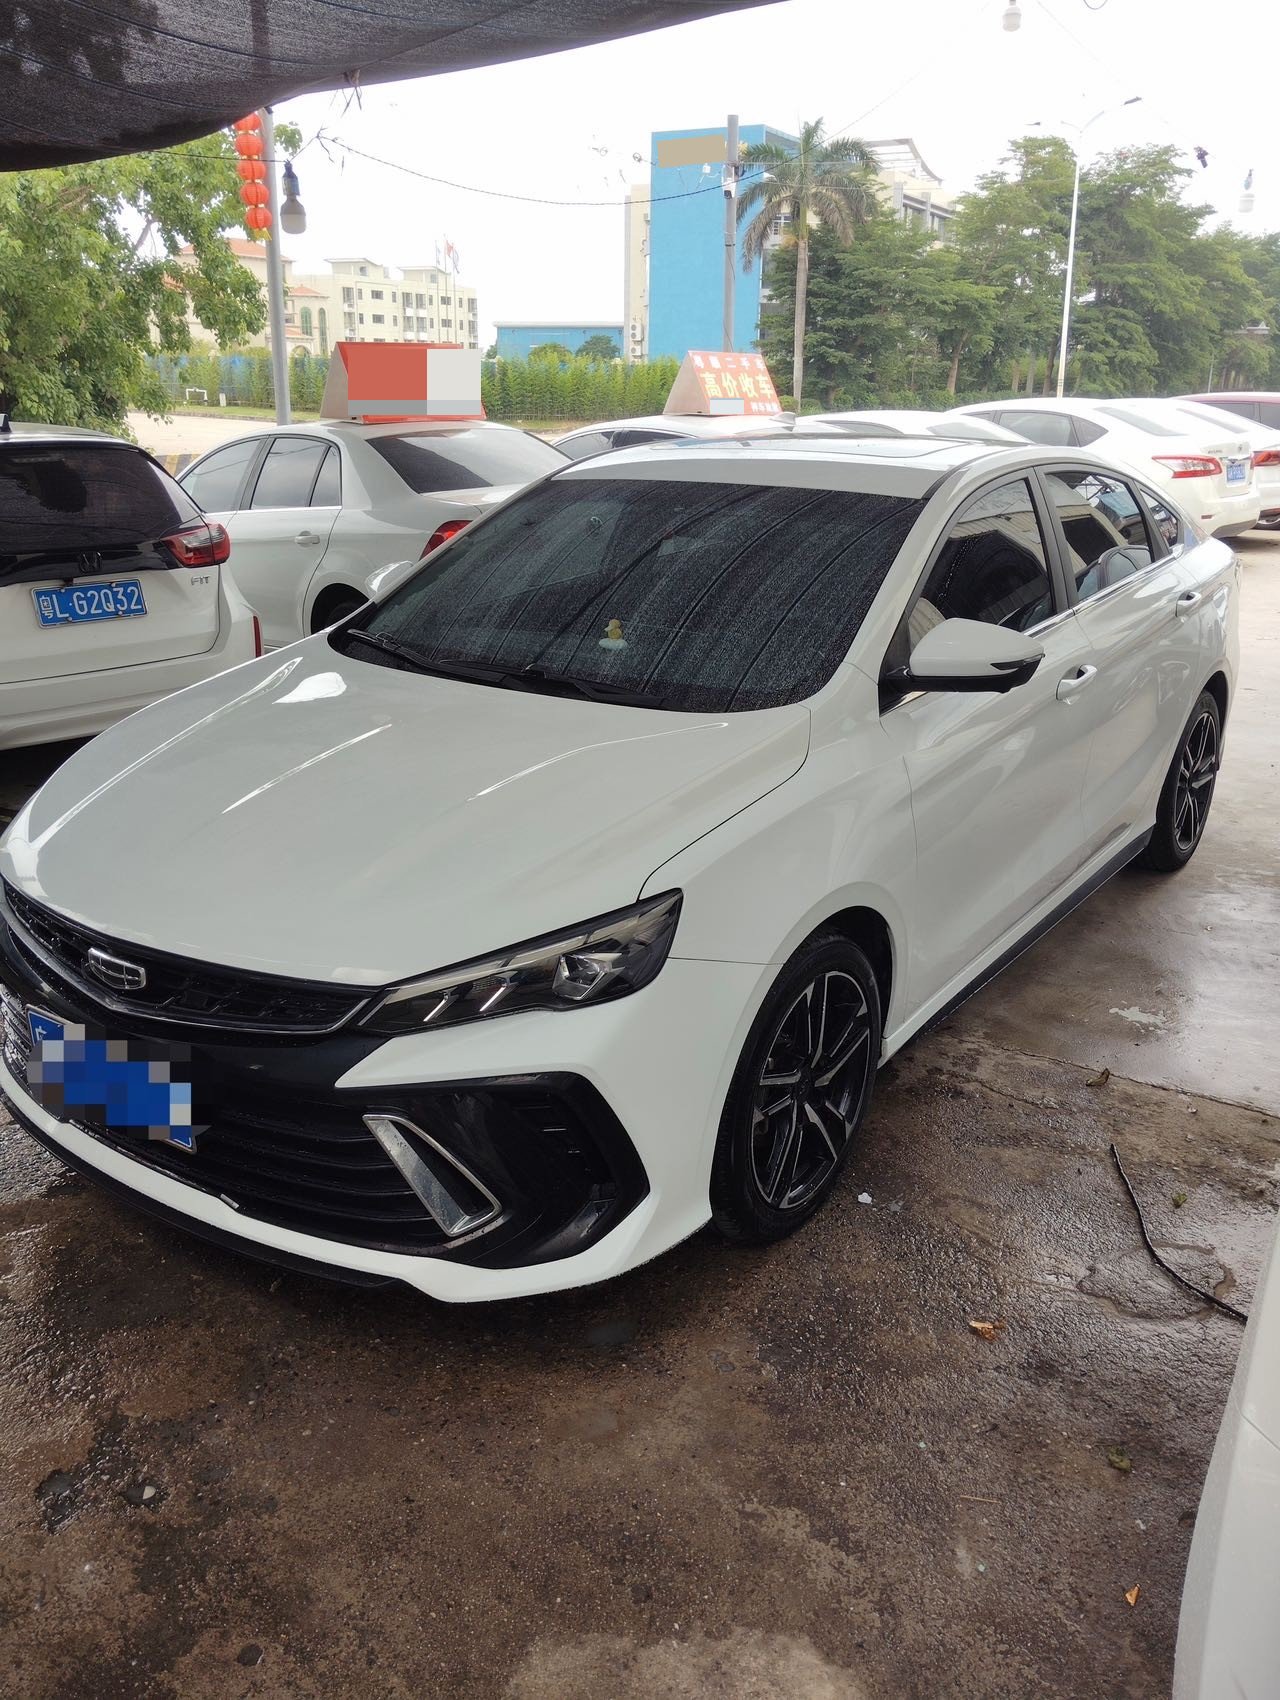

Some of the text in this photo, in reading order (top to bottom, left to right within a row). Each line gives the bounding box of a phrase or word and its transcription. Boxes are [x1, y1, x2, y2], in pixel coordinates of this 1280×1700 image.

[700, 372, 774, 399] 高价收车
[191, 575, 211, 586] FIT
